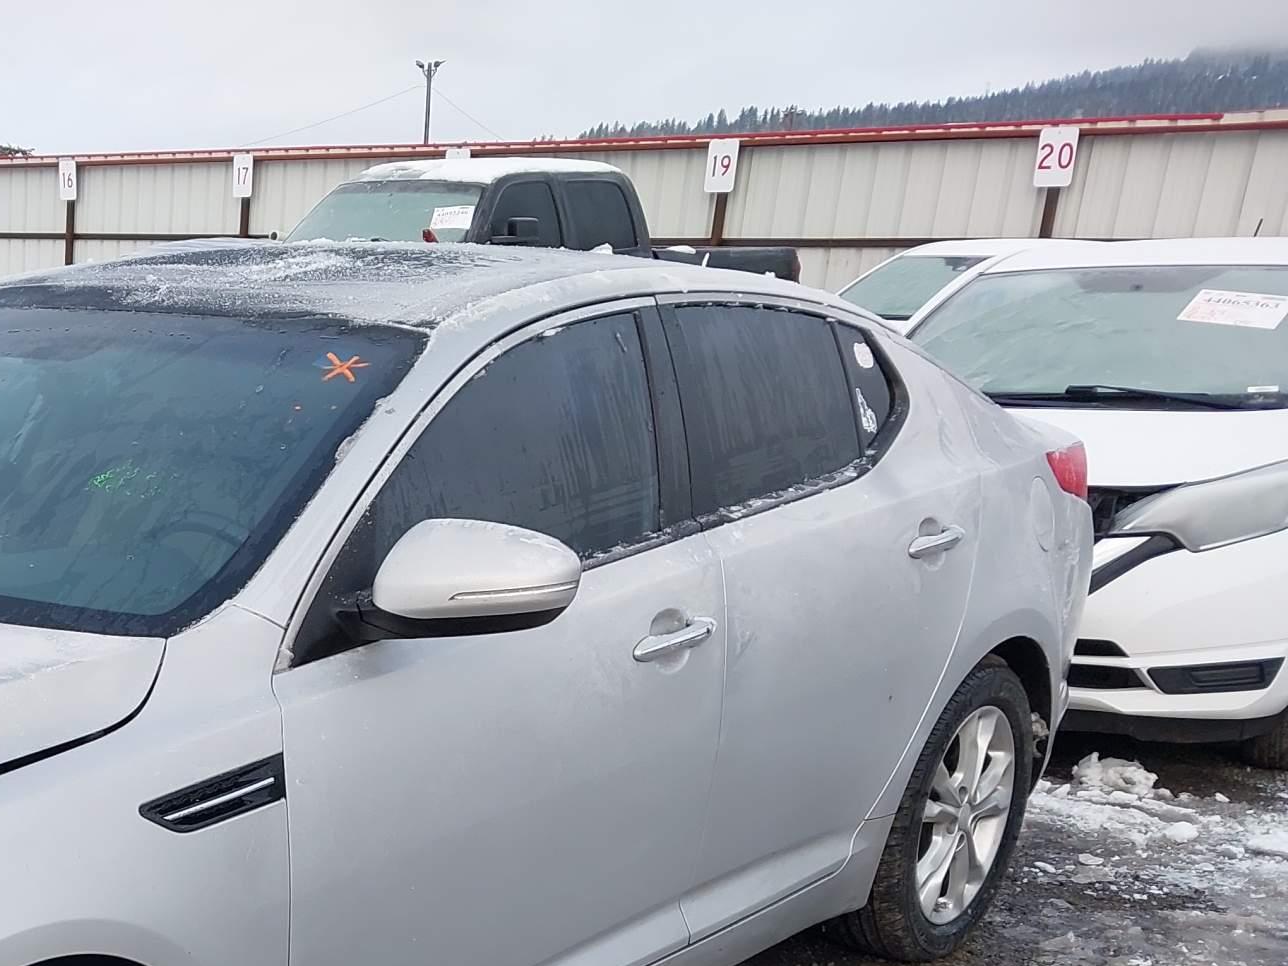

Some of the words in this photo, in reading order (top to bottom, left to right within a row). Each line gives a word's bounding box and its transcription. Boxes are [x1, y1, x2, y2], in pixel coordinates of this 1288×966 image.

[711, 154, 732, 178] 19
[1037, 142, 1074, 170] 20
[62, 172, 74, 189] 16
[237, 167, 249, 185] 17
